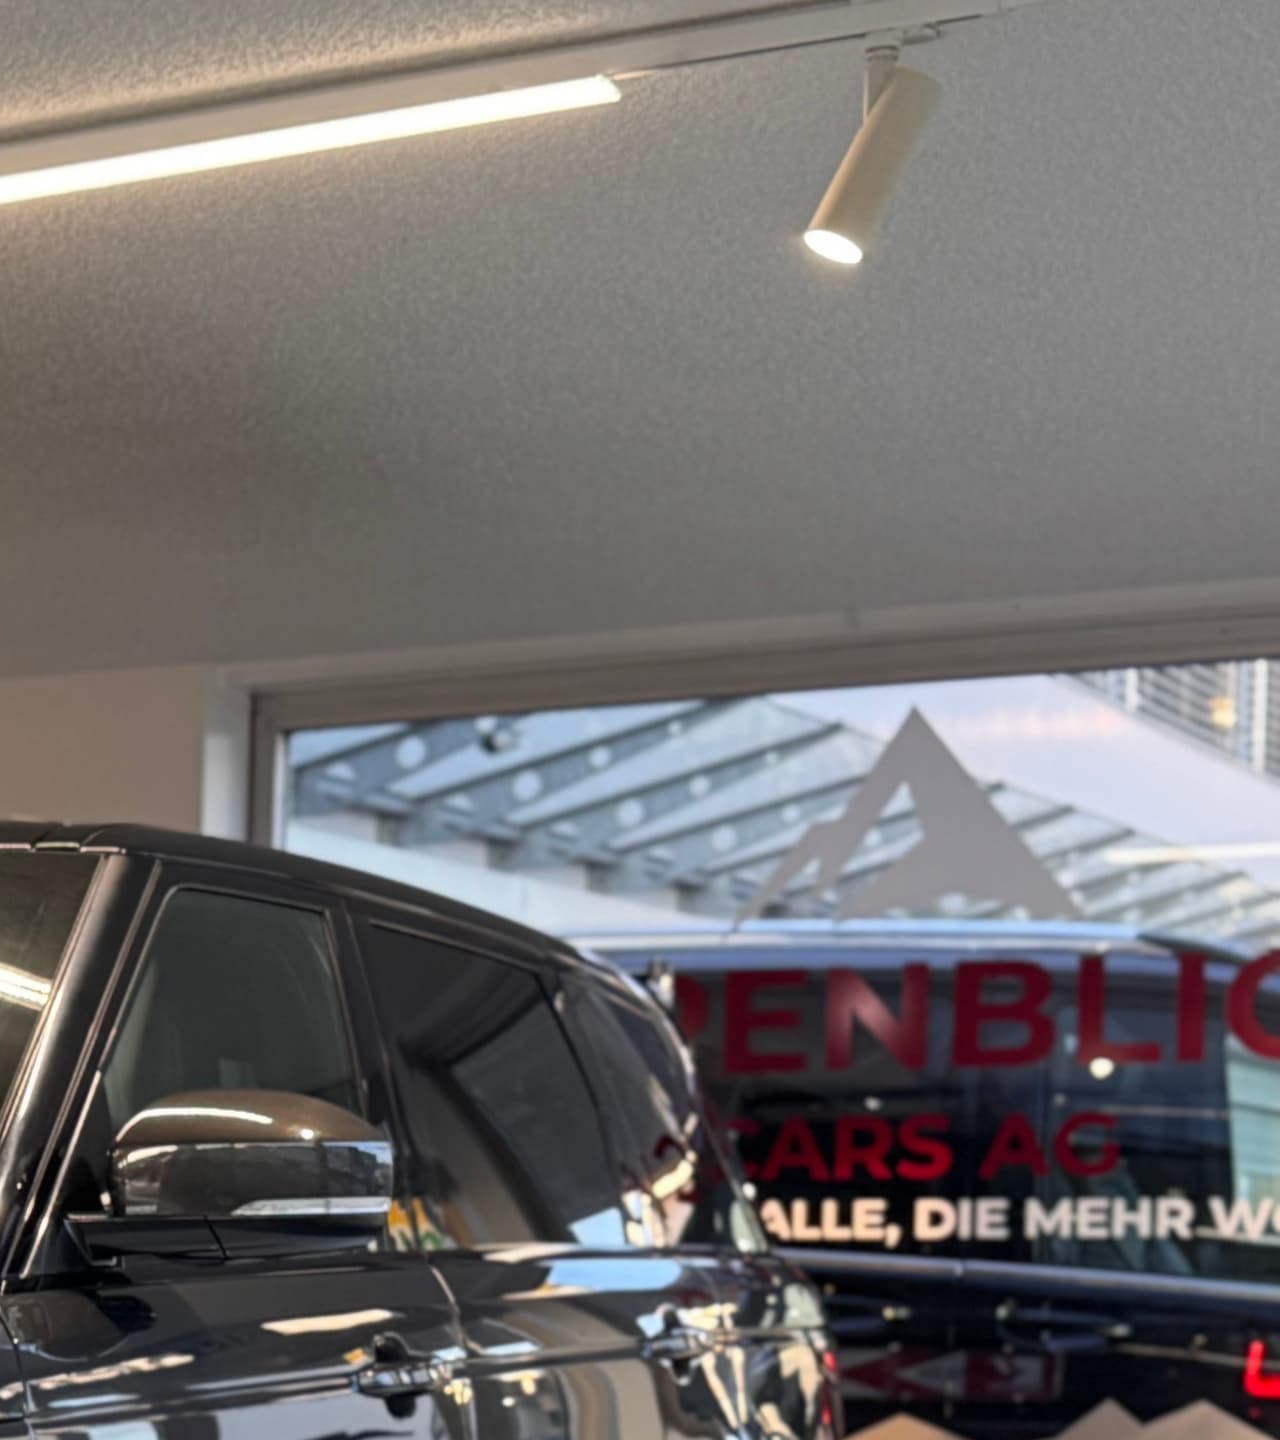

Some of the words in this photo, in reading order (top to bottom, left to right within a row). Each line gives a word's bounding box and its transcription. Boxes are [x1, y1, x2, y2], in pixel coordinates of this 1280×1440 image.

[978, 1111, 1120, 1176] AG
[761, 1197, 903, 1249] ALLE,
[913, 1197, 1009, 1241] DIE
[1023, 1197, 1196, 1242] MEHR
[1208, 1197, 1280, 1240] W
